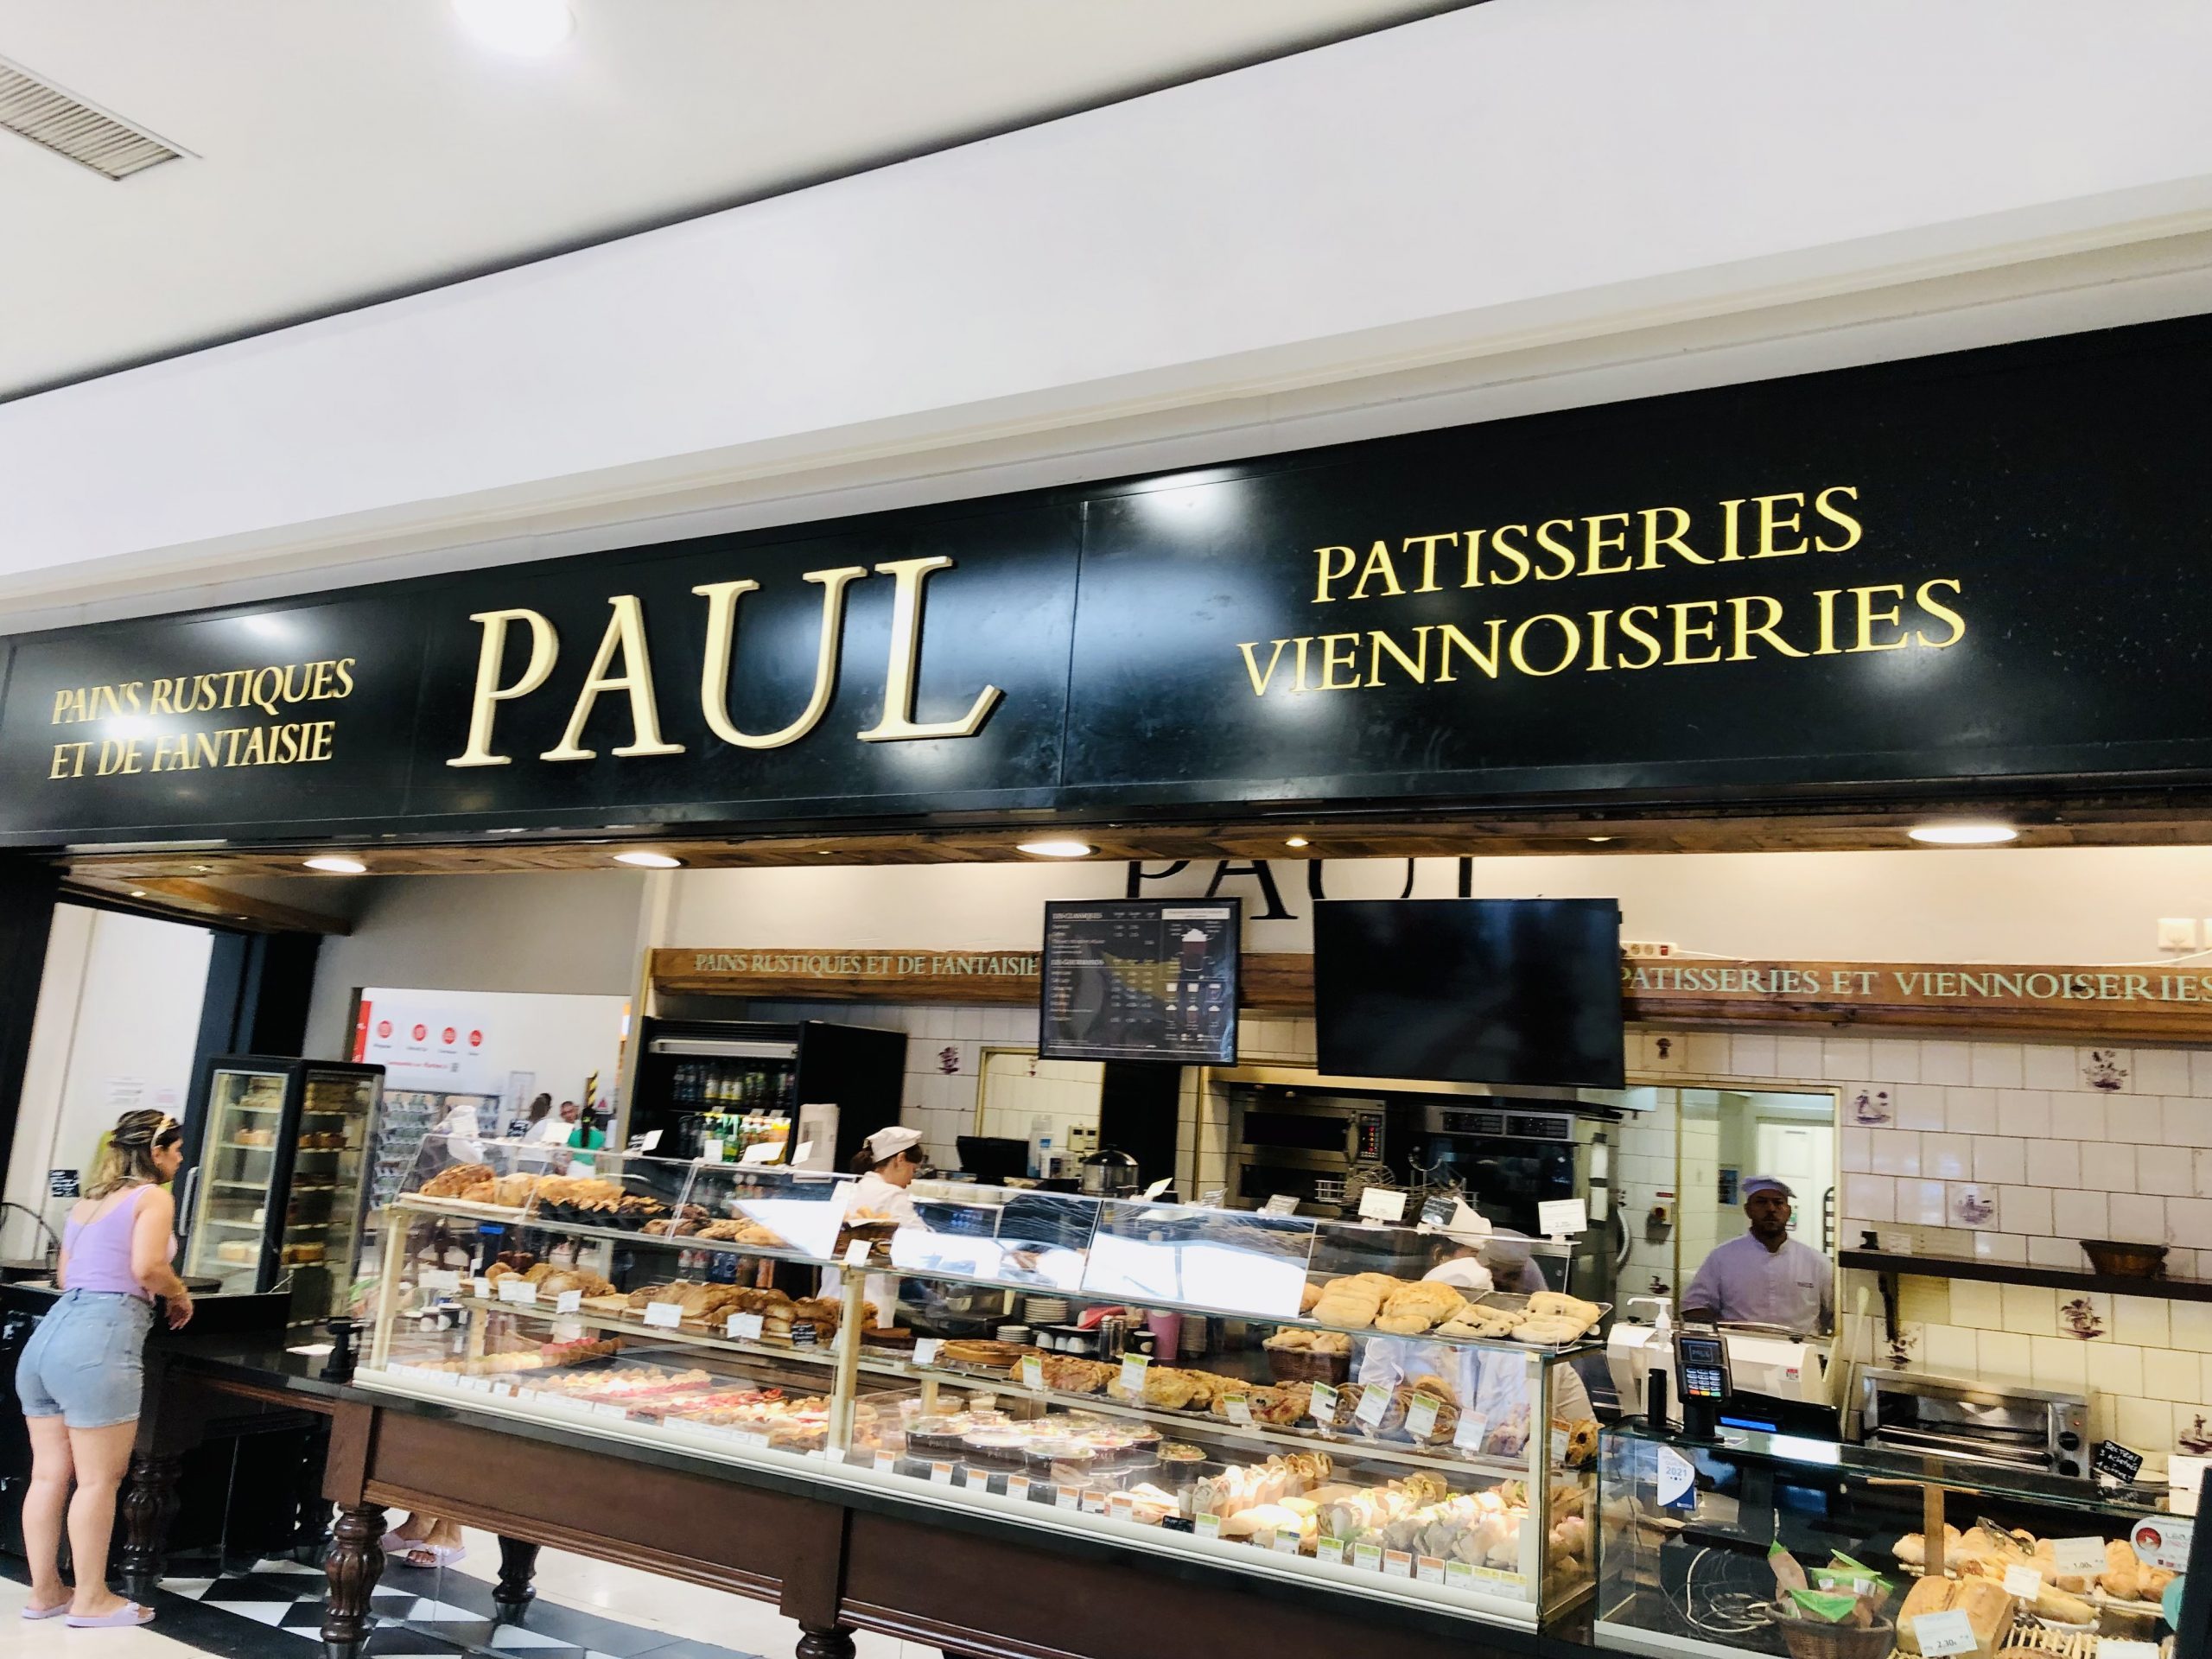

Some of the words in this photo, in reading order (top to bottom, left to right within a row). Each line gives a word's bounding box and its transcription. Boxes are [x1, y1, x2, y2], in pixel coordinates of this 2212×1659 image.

[1311, 486, 1863, 603] PATISSERIES
[445, 555, 1004, 768] PAUL
[1237, 578, 1967, 696] VIENNOISERIES
[50, 681, 143, 725] PAINS
[149, 658, 356, 716] RUSTIQUES
[48, 741, 93, 779] ET
[95, 738, 143, 776] DE
[149, 721, 335, 773] FANTAISIE
[695, 953, 747, 972] PAINS
[750, 954, 862, 977] RUSTIQUES
[867, 956, 893, 974] ET
[898, 956, 925, 975] DE
[931, 957, 1040, 976] FANTAISIE
[1620, 966, 1820, 995] PATISSERIES
[1831, 969, 1879, 995] ET
[1666, 1466, 1688, 1477] 2021
